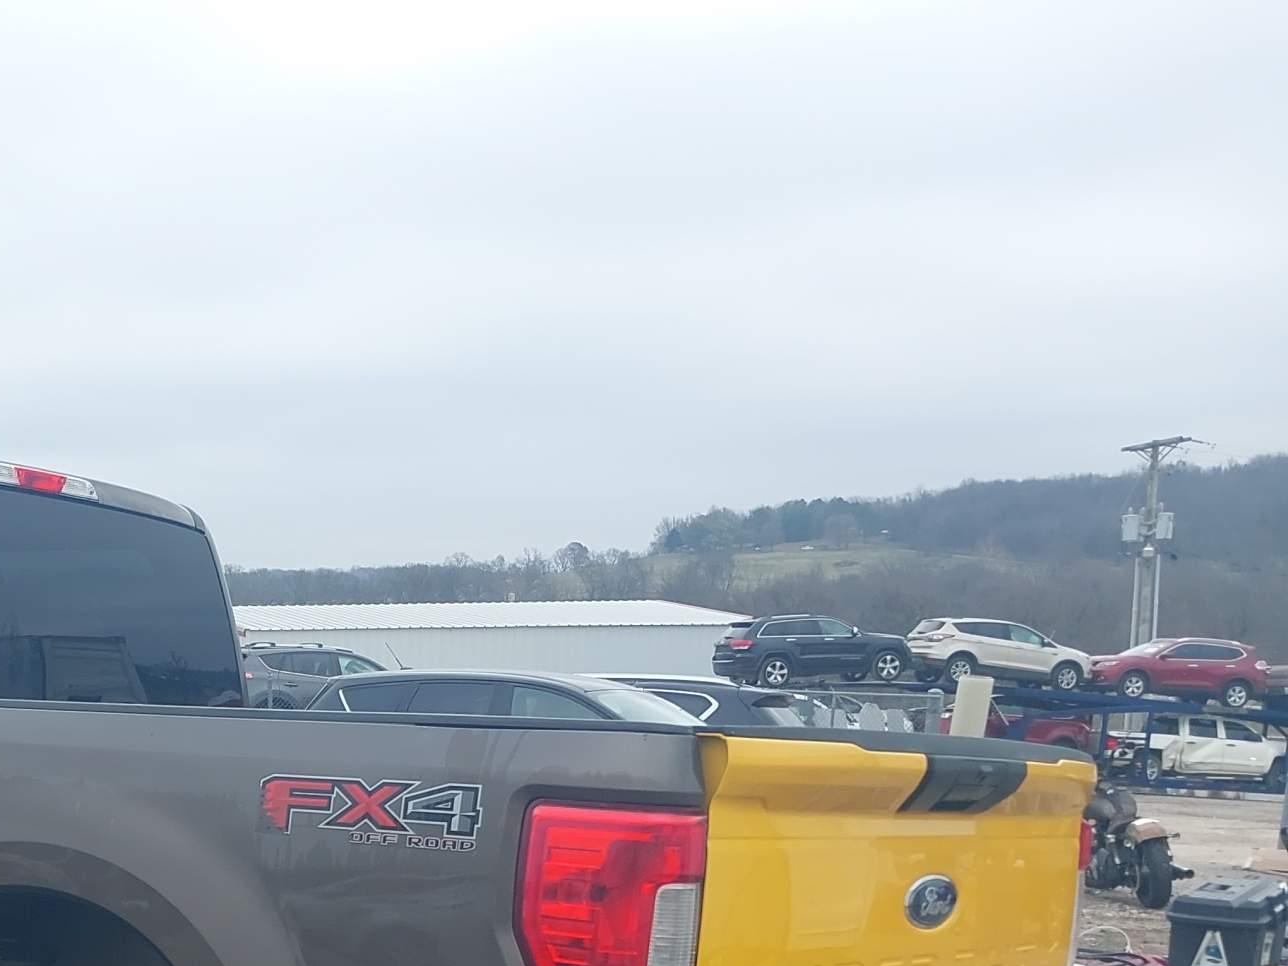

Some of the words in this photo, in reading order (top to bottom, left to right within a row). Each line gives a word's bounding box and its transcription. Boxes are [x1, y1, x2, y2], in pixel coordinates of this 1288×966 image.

[260, 774, 482, 839] FX4
[349, 831, 398, 846] OFF
[406, 835, 476, 851] ROAD
